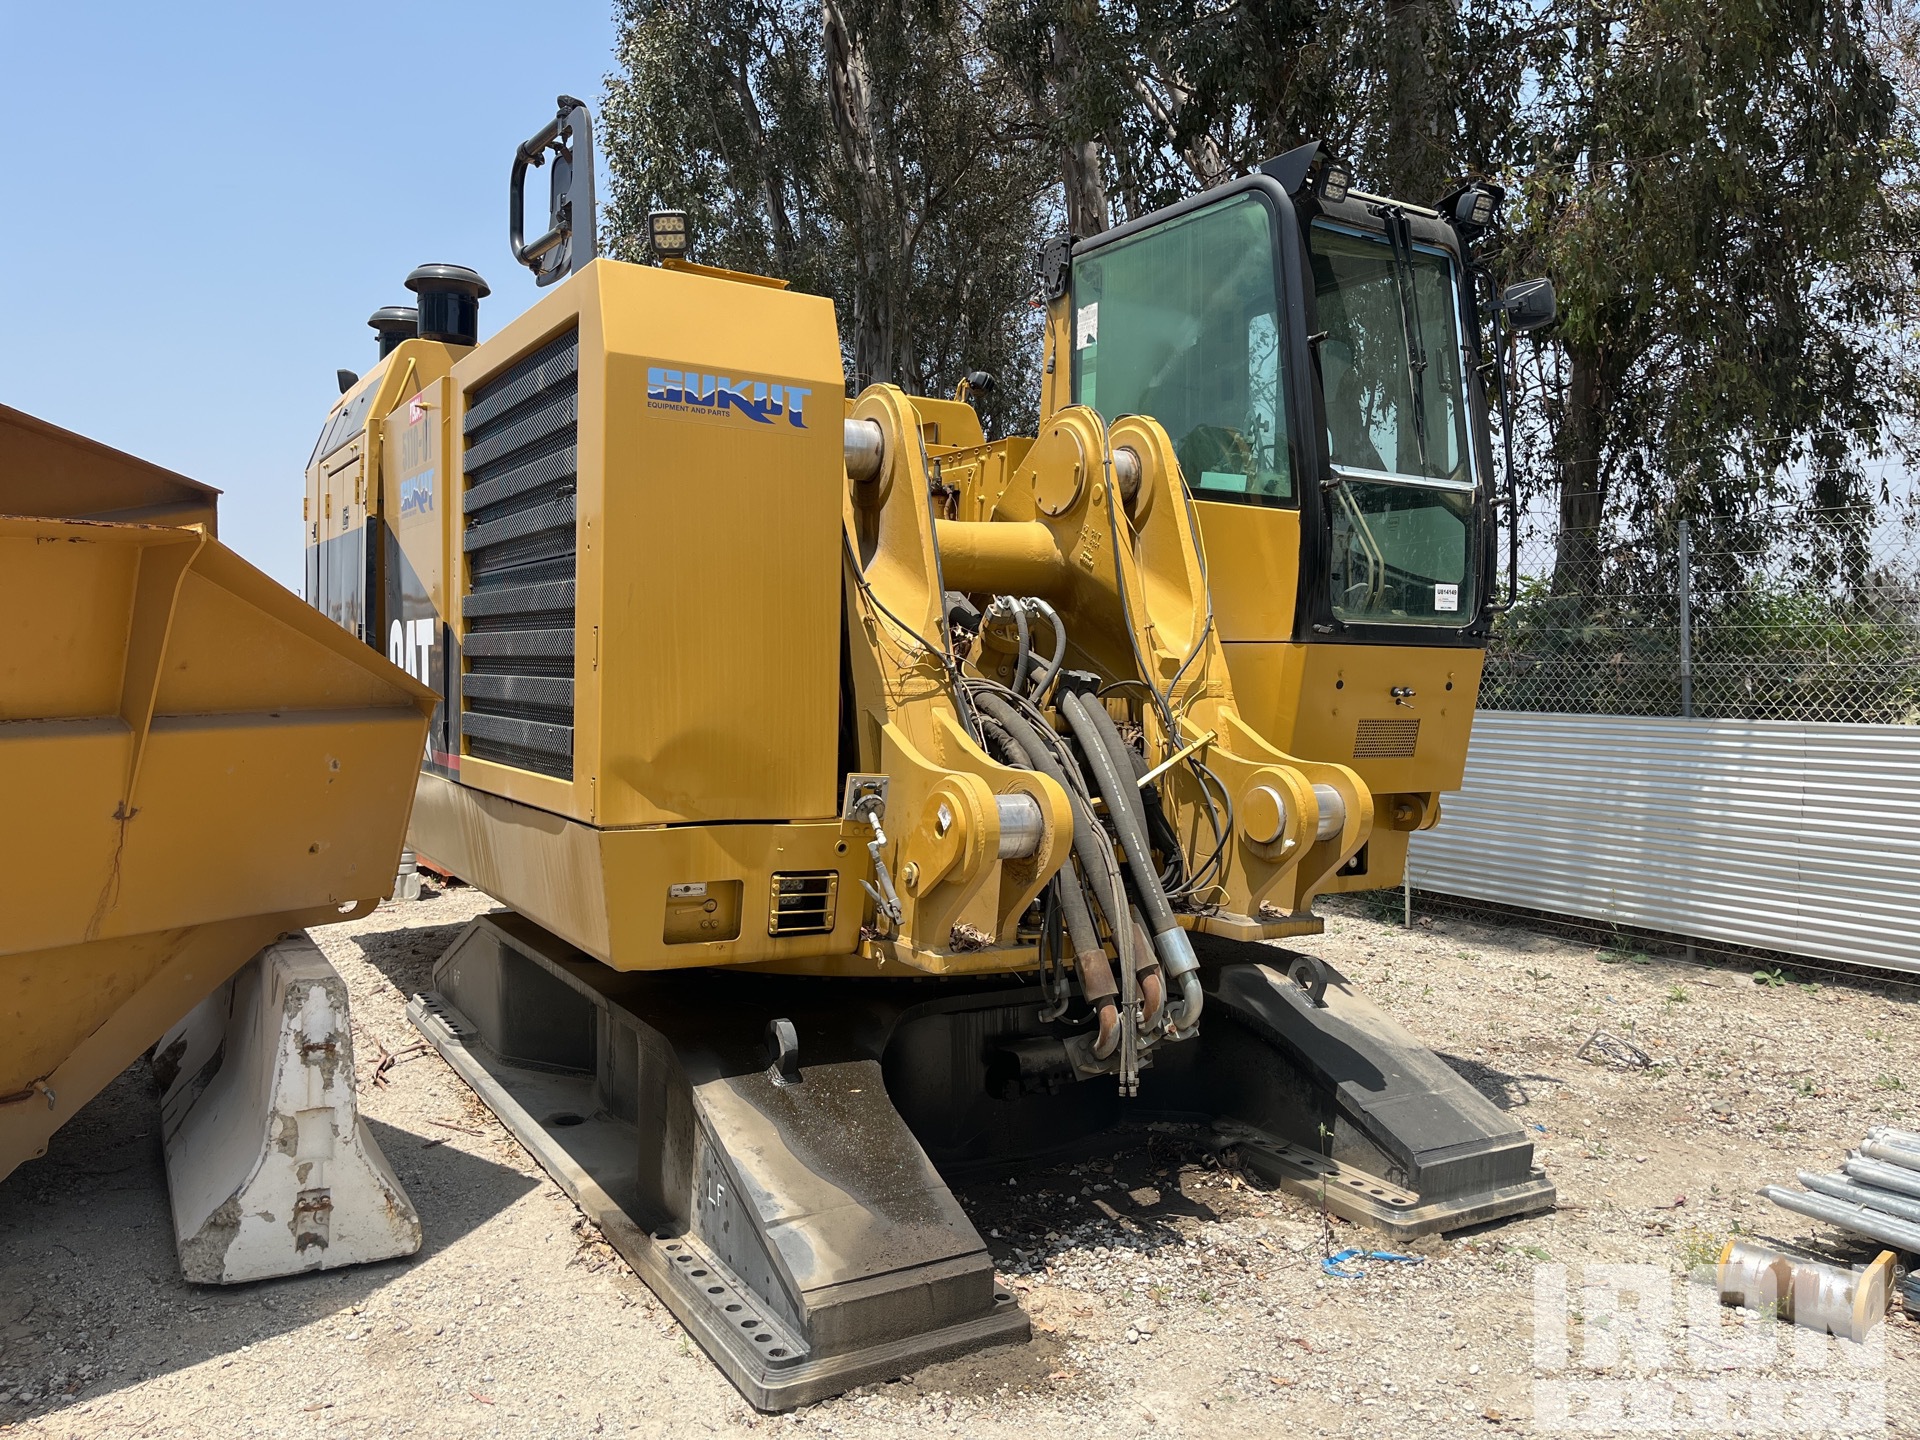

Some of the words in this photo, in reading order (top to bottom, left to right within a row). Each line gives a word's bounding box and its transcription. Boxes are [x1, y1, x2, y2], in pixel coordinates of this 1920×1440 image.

[647, 366, 812, 429] SUKUT
[647, 401, 690, 413] EQUIPMENT
[690, 406, 706, 415] AND
[707, 408, 731, 418] PARTS
[708, 1177, 725, 1207] LF
